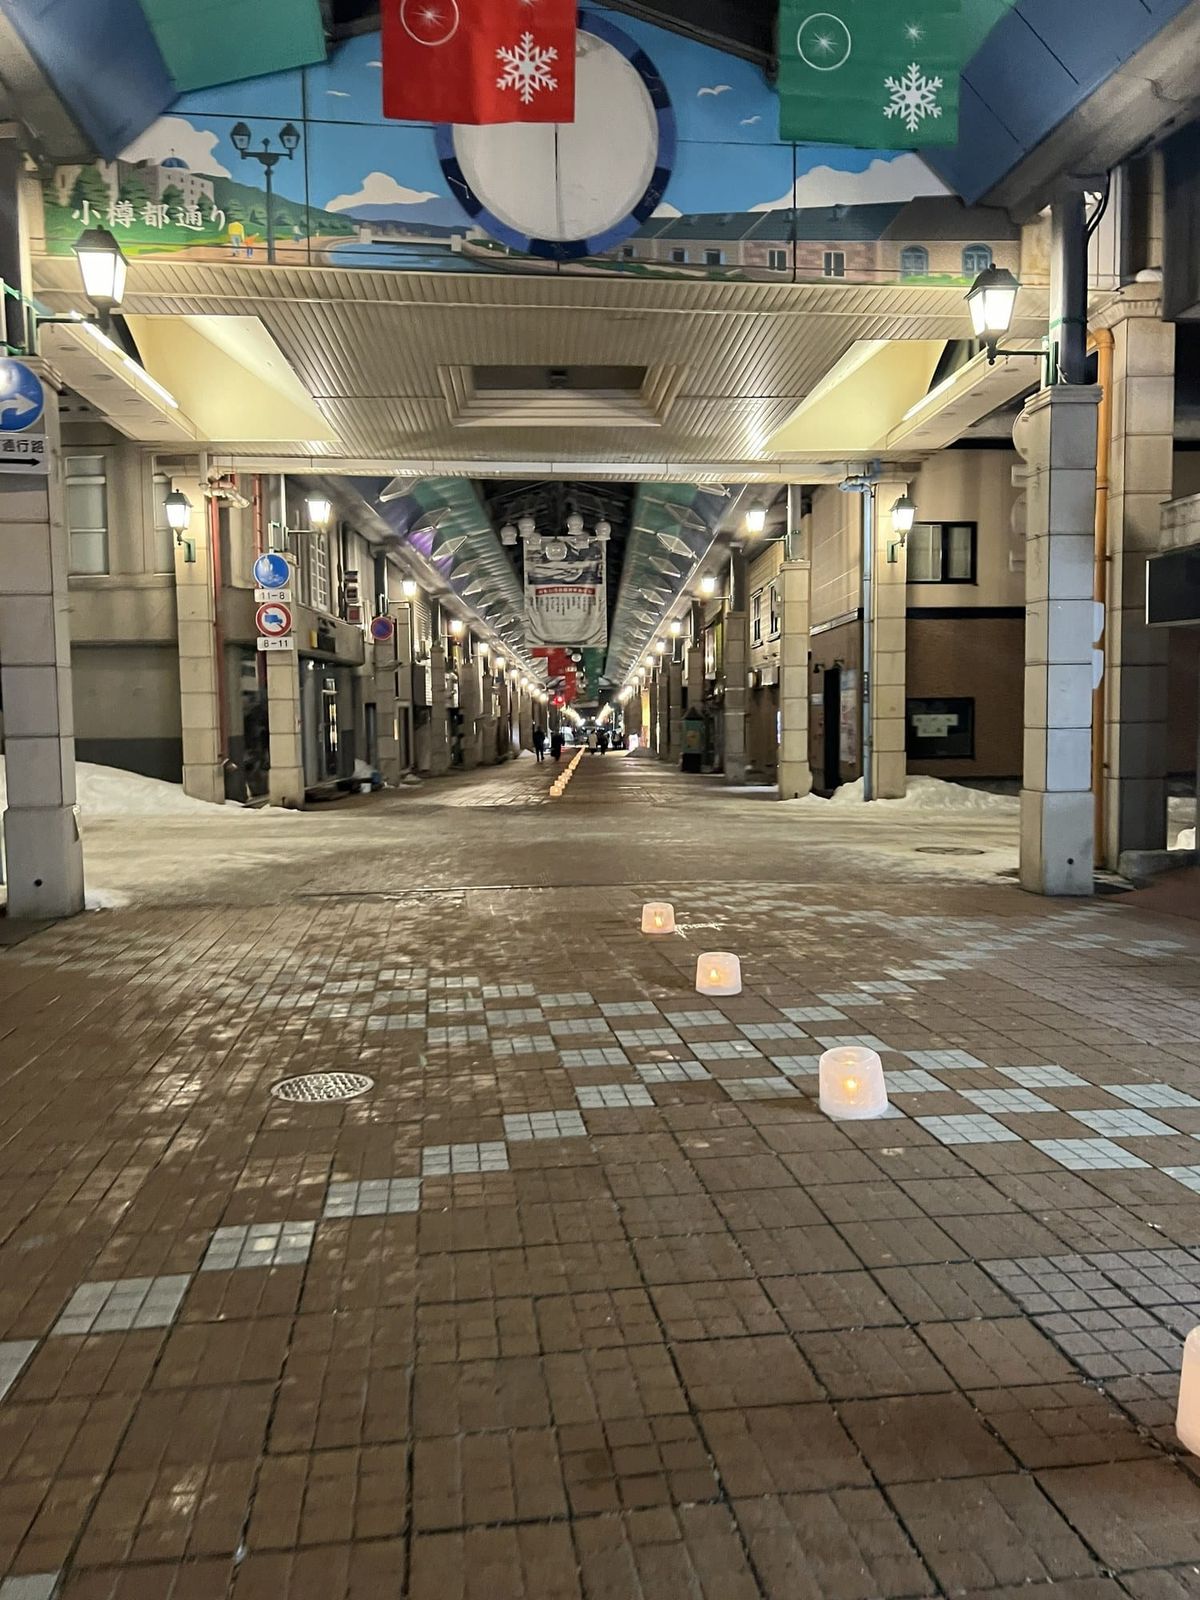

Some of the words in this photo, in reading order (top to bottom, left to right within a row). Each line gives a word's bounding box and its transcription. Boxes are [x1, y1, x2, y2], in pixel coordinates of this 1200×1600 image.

[71, 200, 226, 231] 小樽都通り
[263, 639, 288, 648] 8-11
